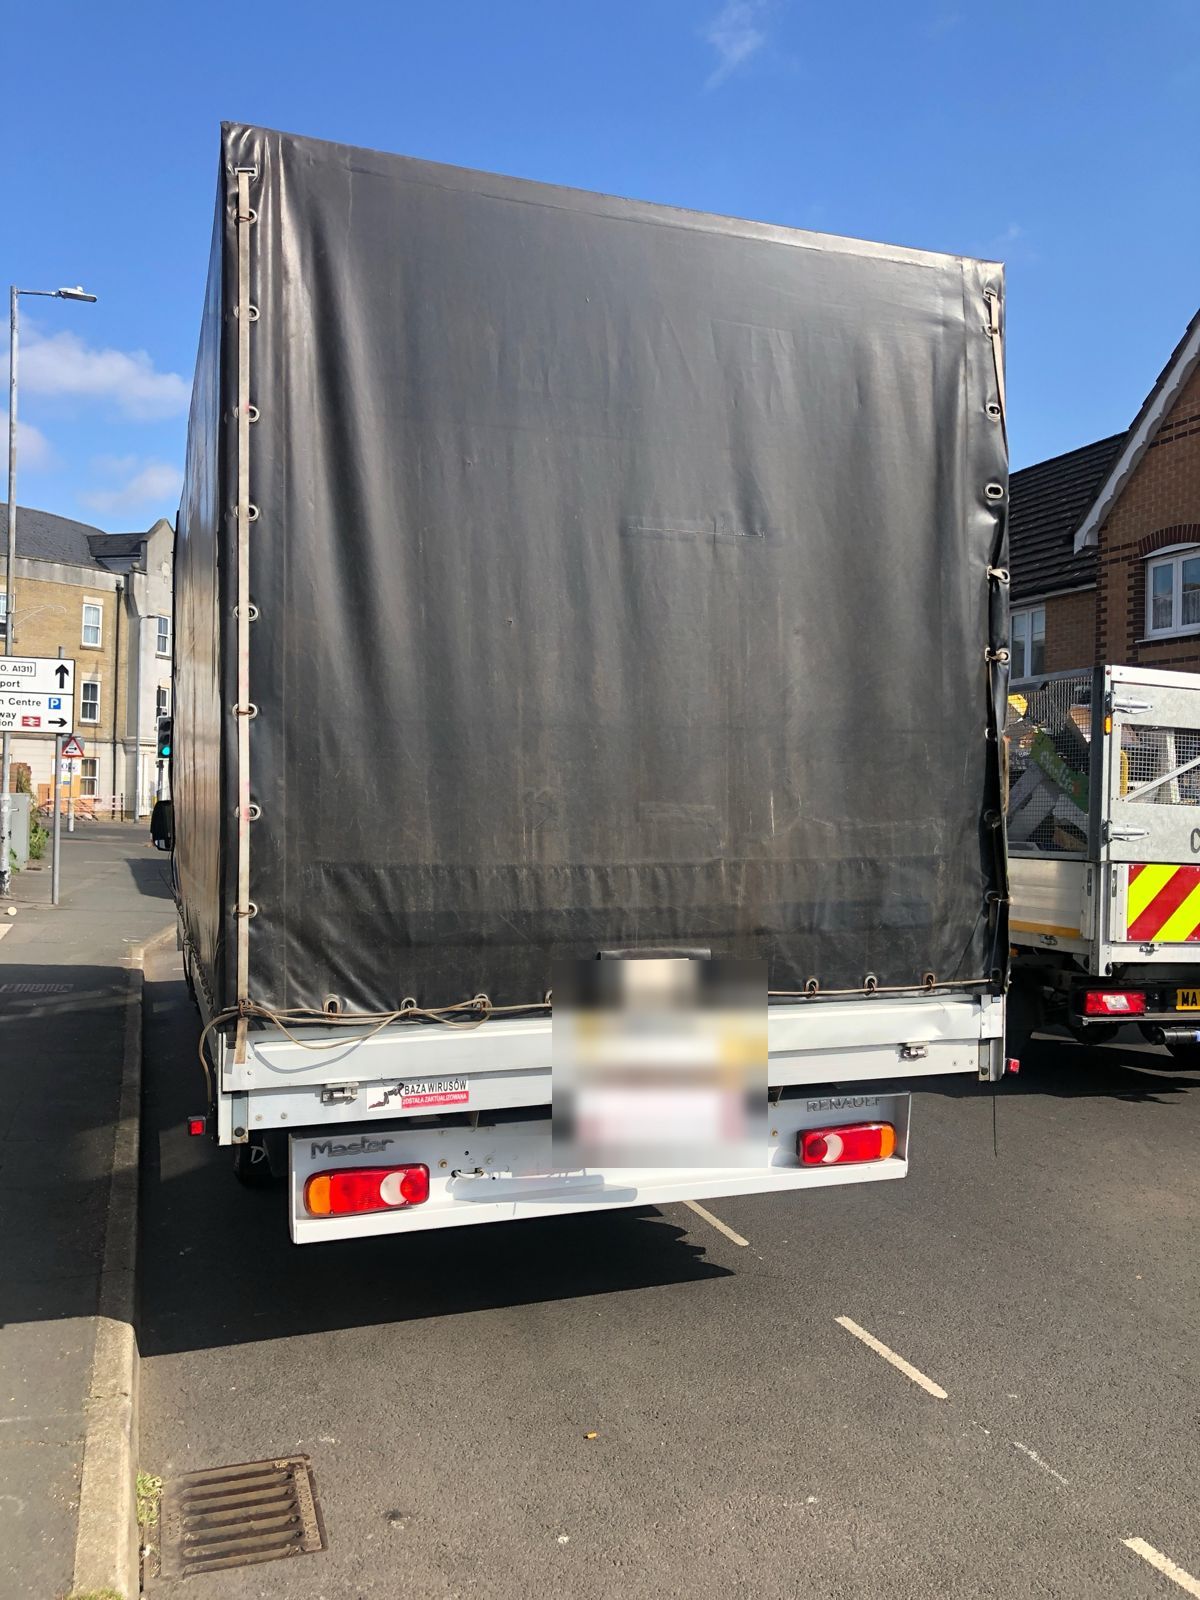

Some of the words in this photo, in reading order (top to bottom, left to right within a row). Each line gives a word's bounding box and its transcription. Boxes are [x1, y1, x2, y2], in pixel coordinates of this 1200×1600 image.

[12, 665, 33, 673] A131)
[8, 697, 41, 706] Centre
[404, 1083, 427, 1095] BAZA
[427, 1078, 467, 1093] WIRUSÓW
[806, 1097, 880, 1112] RENAULT
[311, 1136, 394, 1159] Master
